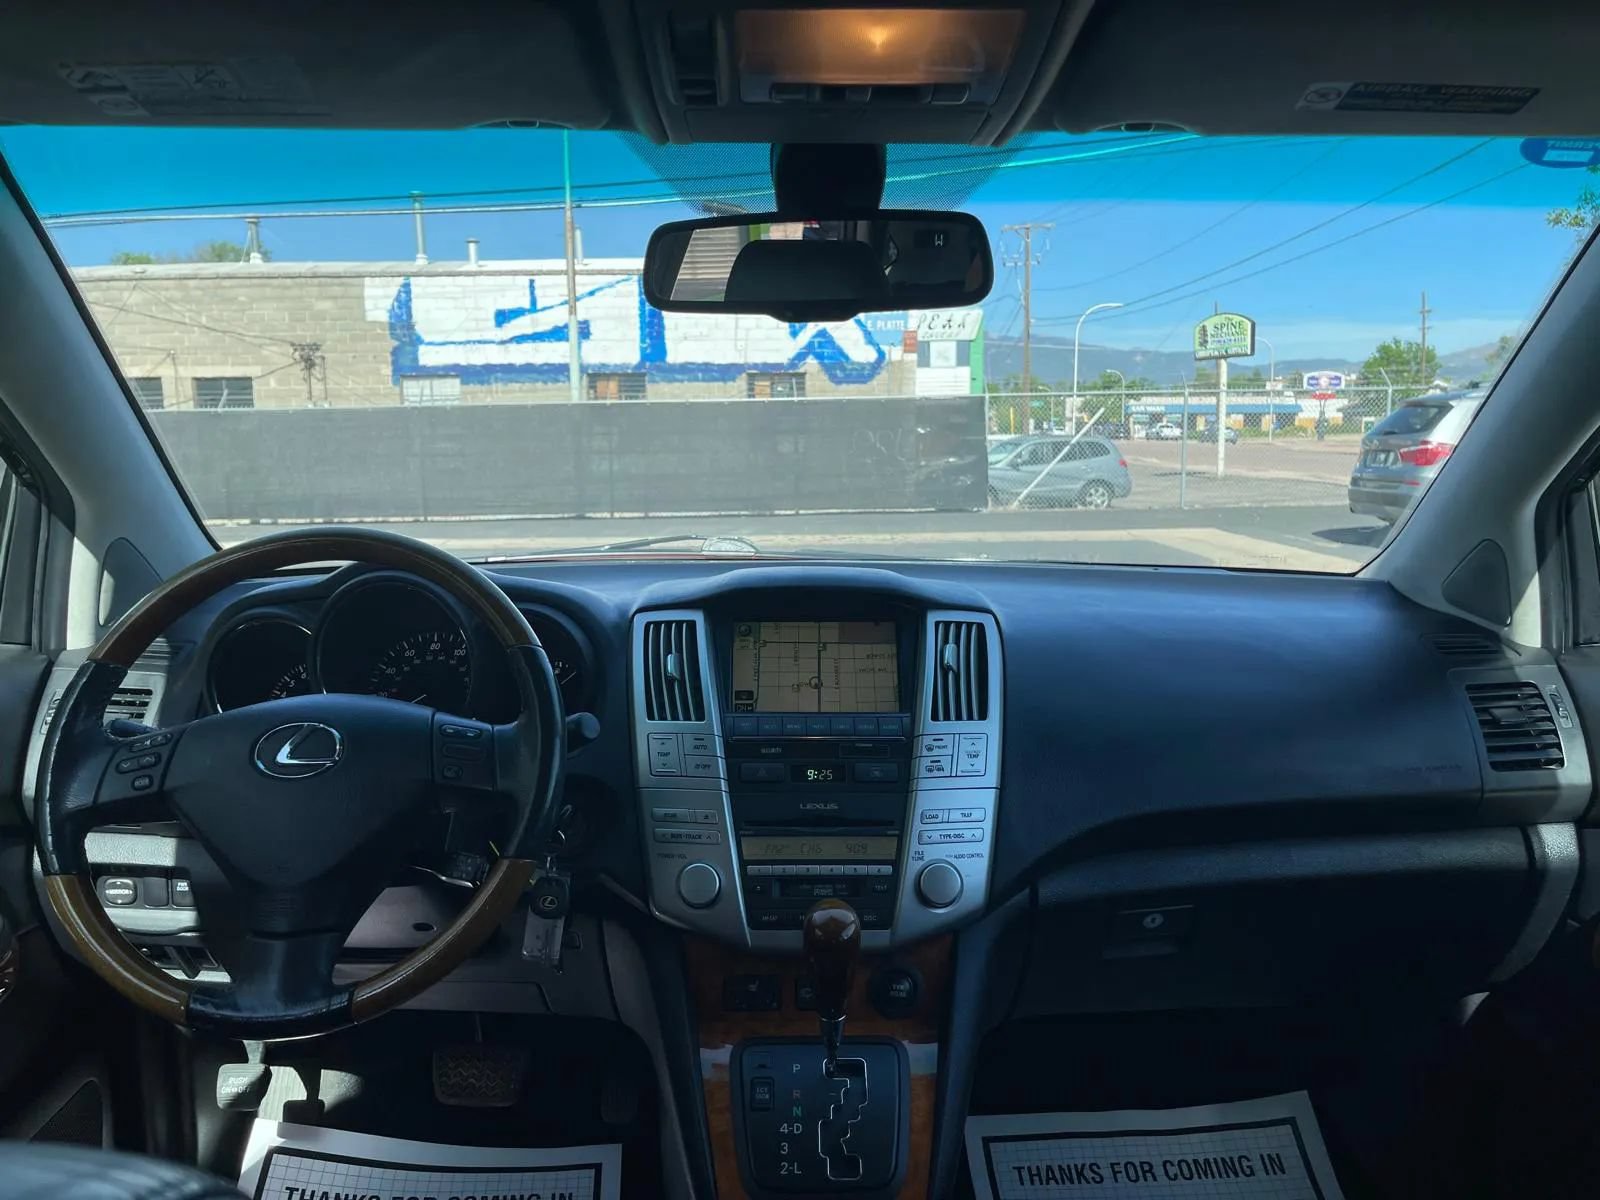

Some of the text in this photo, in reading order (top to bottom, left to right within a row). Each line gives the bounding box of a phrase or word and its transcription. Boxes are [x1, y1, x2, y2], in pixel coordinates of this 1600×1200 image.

[1354, 84, 1532, 97] AIRBAG WARNING
[934, 233, 943, 246] W
[876, 319, 905, 330] PLATTE
[1214, 320, 1245, 331] SPINE
[430, 642, 441, 650] 80
[288, 679, 295, 687] 5
[807, 769, 833, 780] 9:25
[799, 802, 839, 810] LEXUS
[792, 1064, 801, 1073] P
[228, 1076, 249, 1084] PUSH
[792, 1089, 801, 1099] R
[792, 1106, 802, 1117] N
[779, 1123, 803, 1134] 4-D
[780, 1142, 789, 1154] 3
[780, 1162, 802, 1175] 2-L
[1012, 1152, 1287, 1187] THANKS FOR COMING IN
